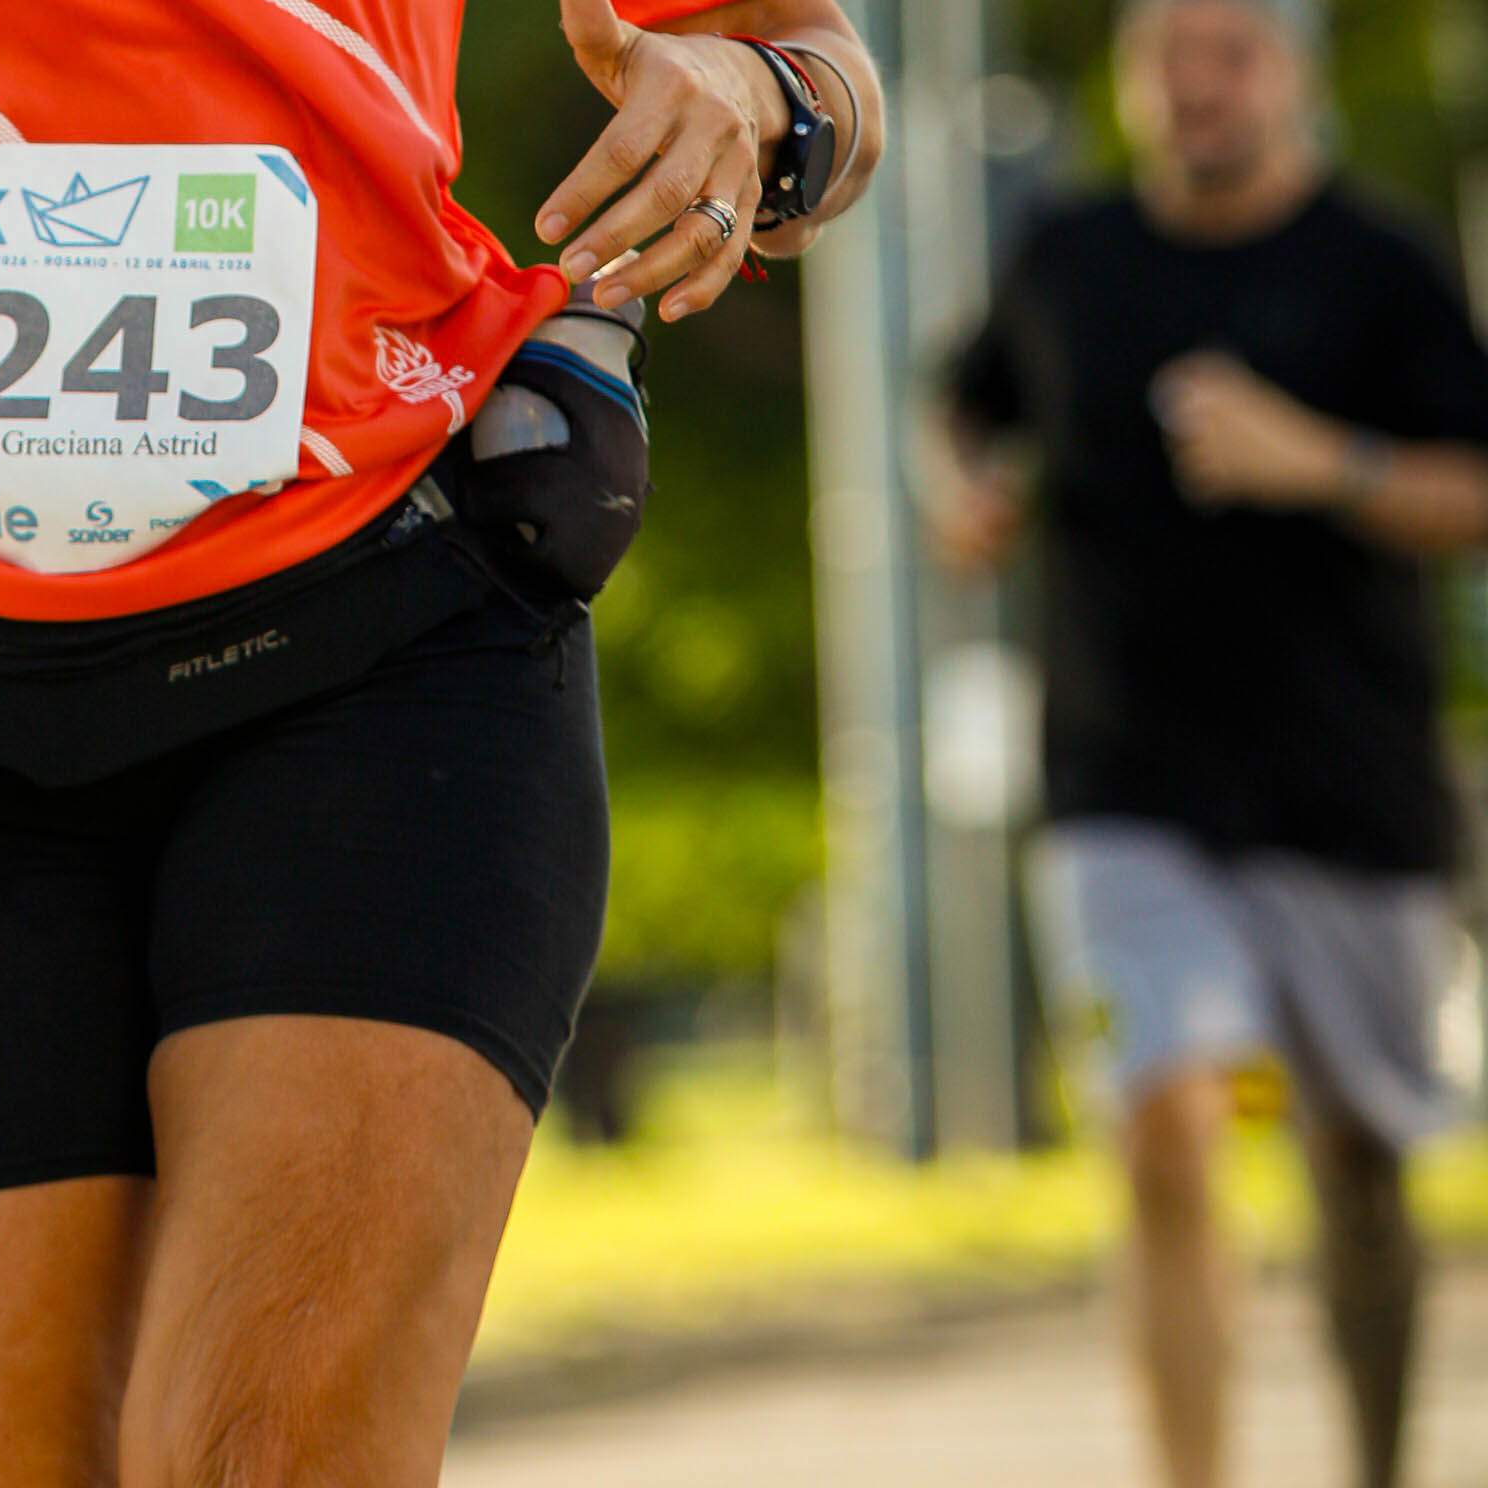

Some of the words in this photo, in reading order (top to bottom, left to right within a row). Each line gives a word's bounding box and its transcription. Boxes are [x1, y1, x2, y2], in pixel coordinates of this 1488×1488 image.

[183, 197, 246, 229] 10K
[43, 256, 108, 268] ROSARIO
[125, 258, 141, 269] 12
[146, 258, 164, 269] DE
[169, 259, 211, 271] ABRIL
[218, 259, 252, 271] 2026
[2, 431, 124, 456] Graciana
[134, 431, 218, 456] Astrid
